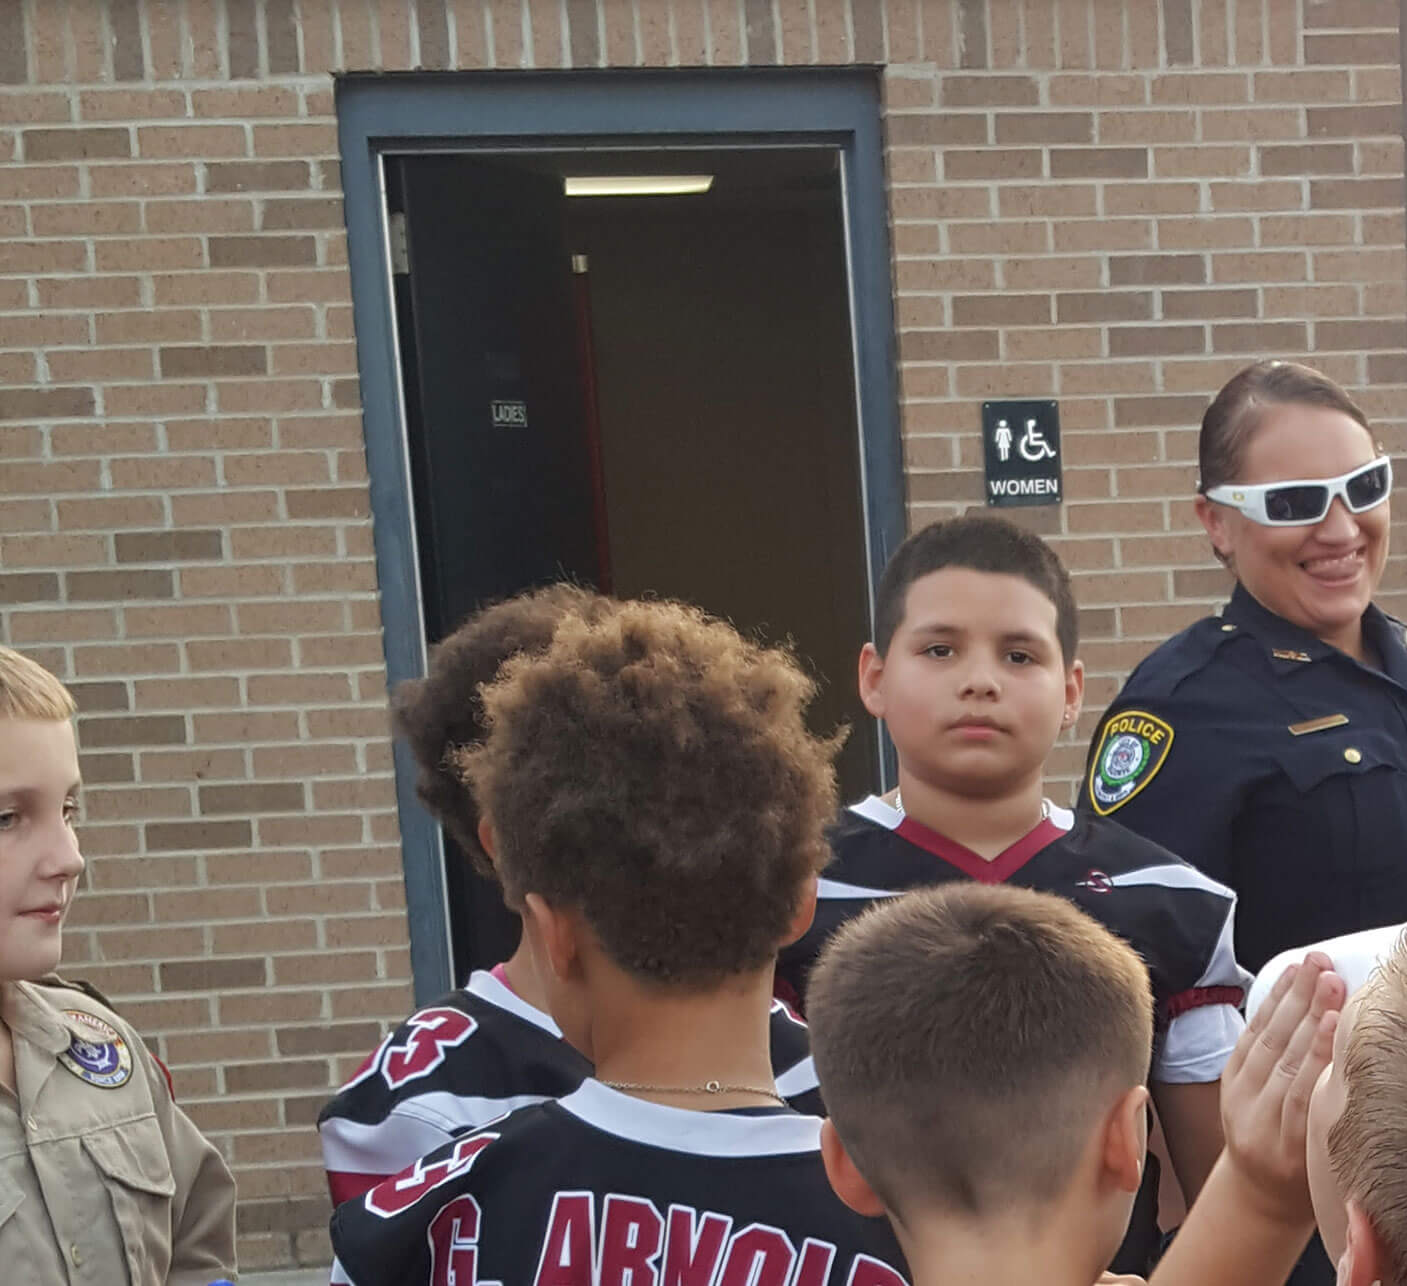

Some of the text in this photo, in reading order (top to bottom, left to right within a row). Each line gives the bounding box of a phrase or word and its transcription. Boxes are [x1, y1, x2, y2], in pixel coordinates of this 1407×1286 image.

[492, 405, 525, 422] LADIES
[990, 479, 1058, 496] WOMEN
[1110, 717, 1165, 745] POLICE
[428, 1191, 910, 1286] G ARNO
